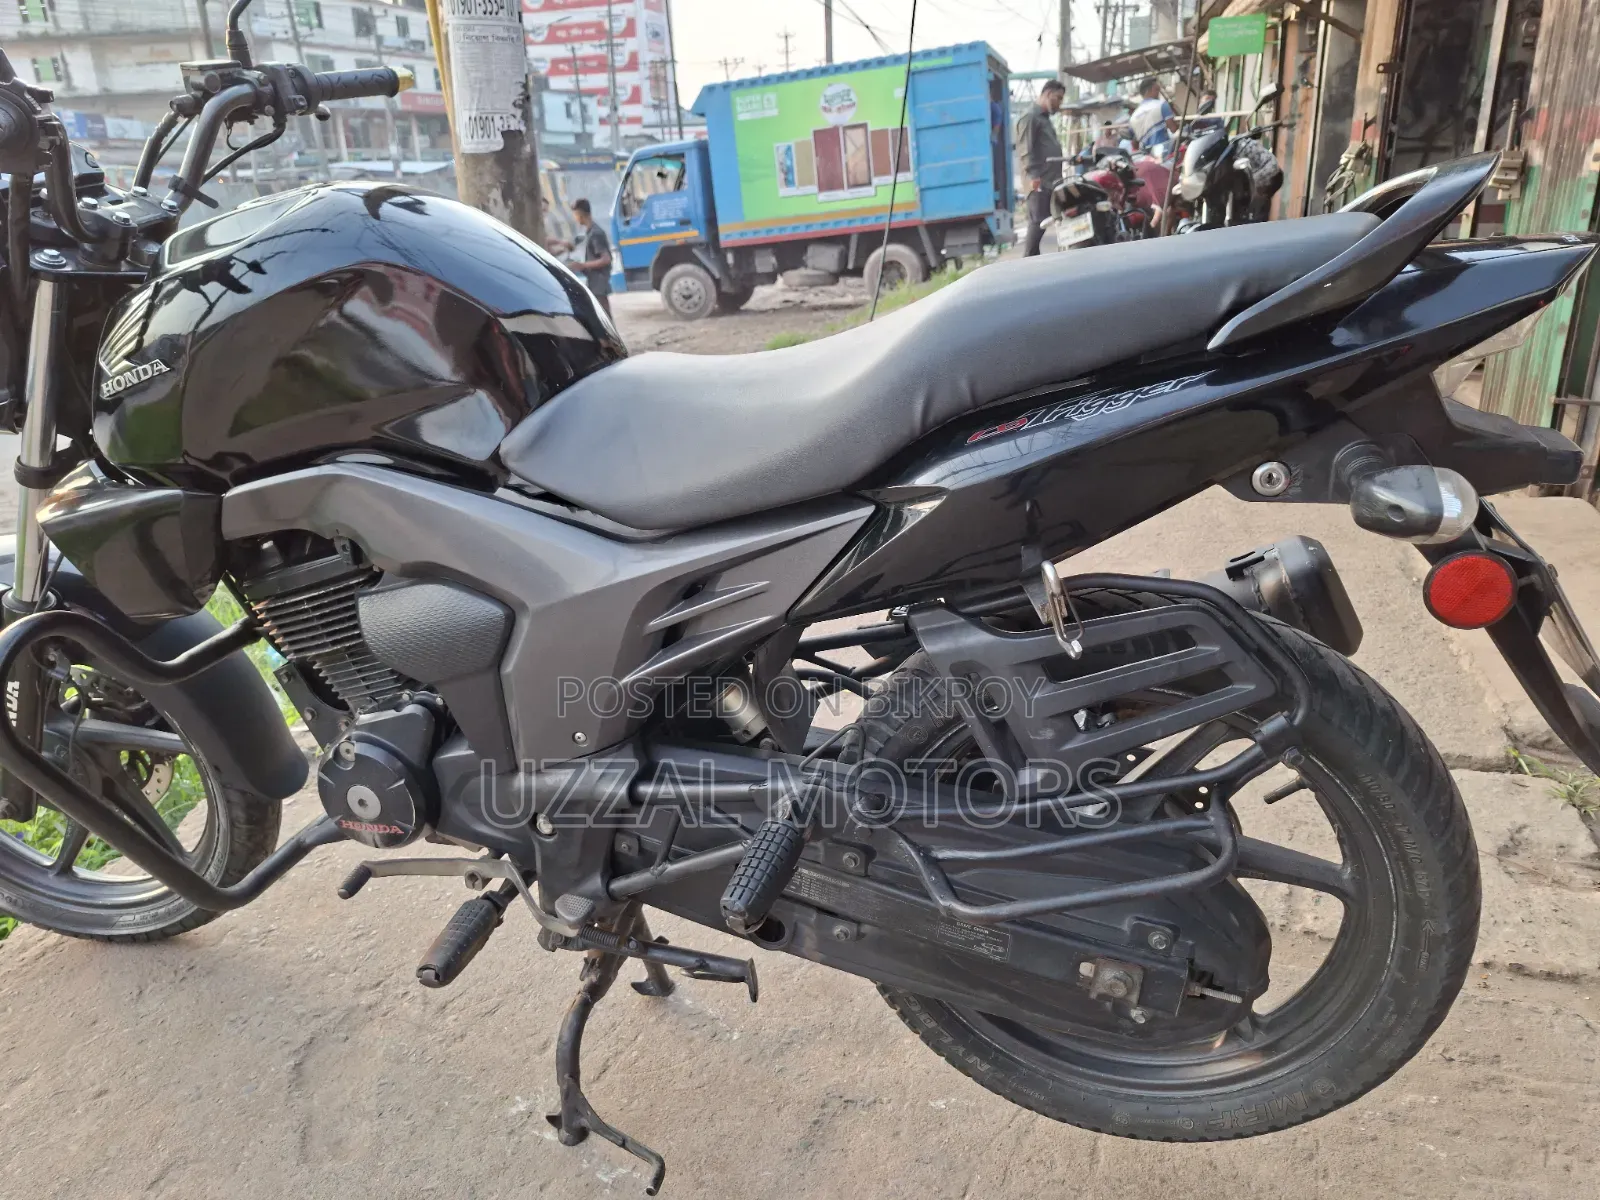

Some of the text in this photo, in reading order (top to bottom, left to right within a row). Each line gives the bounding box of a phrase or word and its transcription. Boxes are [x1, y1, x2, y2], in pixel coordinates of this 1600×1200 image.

[100, 359, 170, 399] HONDA
[1019, 368, 1220, 432] Trigger
[339, 820, 405, 835] HONDA
[1204, 1086, 1311, 1131] MRF
